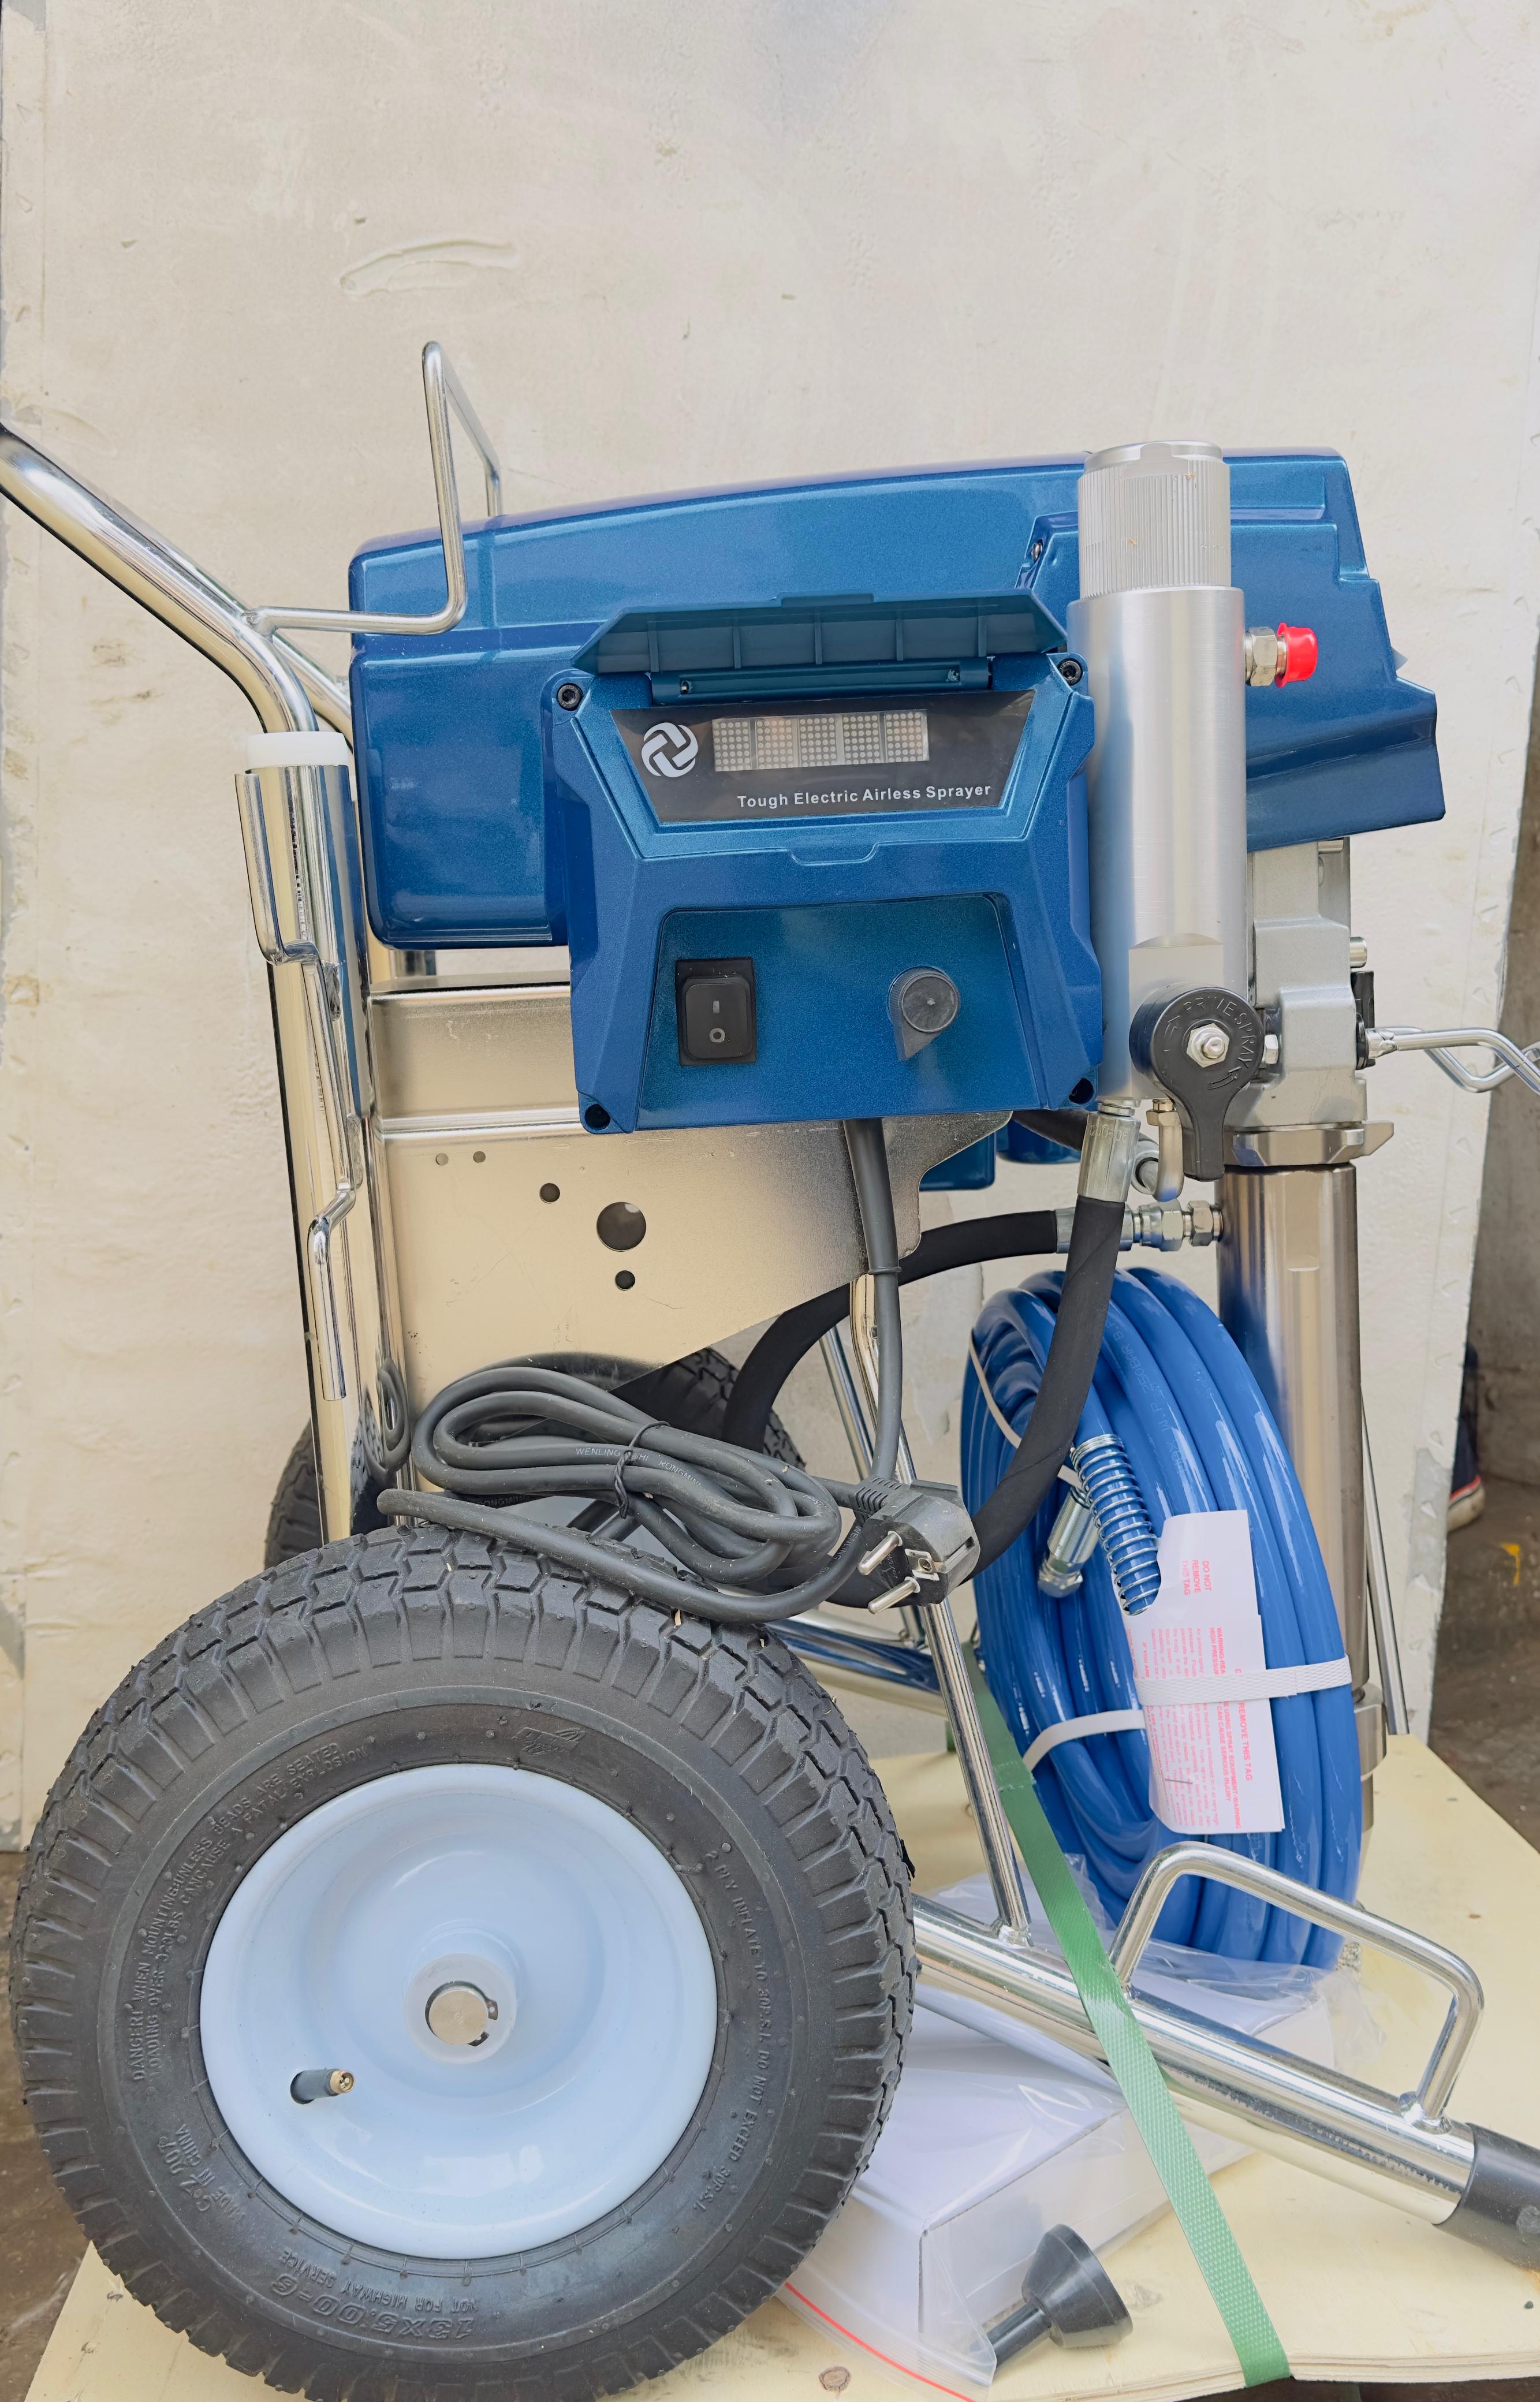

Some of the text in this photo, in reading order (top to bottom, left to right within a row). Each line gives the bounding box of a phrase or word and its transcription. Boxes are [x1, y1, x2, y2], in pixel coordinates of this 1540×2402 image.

[737, 784, 991, 808] Tough Electric Airless Sprayer
[1233, 1012, 1257, 1069] SPRAY
[576, 1446, 621, 1457] WENLING
[833, 1525, 863, 1560] WENLING
[1181, 1560, 1191, 1595] THIS TAG
[1191, 1559, 1201, 1593] REMOVE
[1202, 1560, 1211, 1591] DO NOT
[1216, 1627, 1226, 1673] WARNING-REA
[1238, 1702, 1252, 1781] REMOVE THIS TAG
[1220, 1745, 1228, 1776] SERIOUS
[756, 2049, 771, 2069] DO
[747, 2075, 767, 2105] NOT
[172, 2123, 204, 2168] CHINA
[725, 2109, 759, 2164] EXCEED
[277, 2247, 476, 2314] NOT FOR HIGHWAY SERVICE
